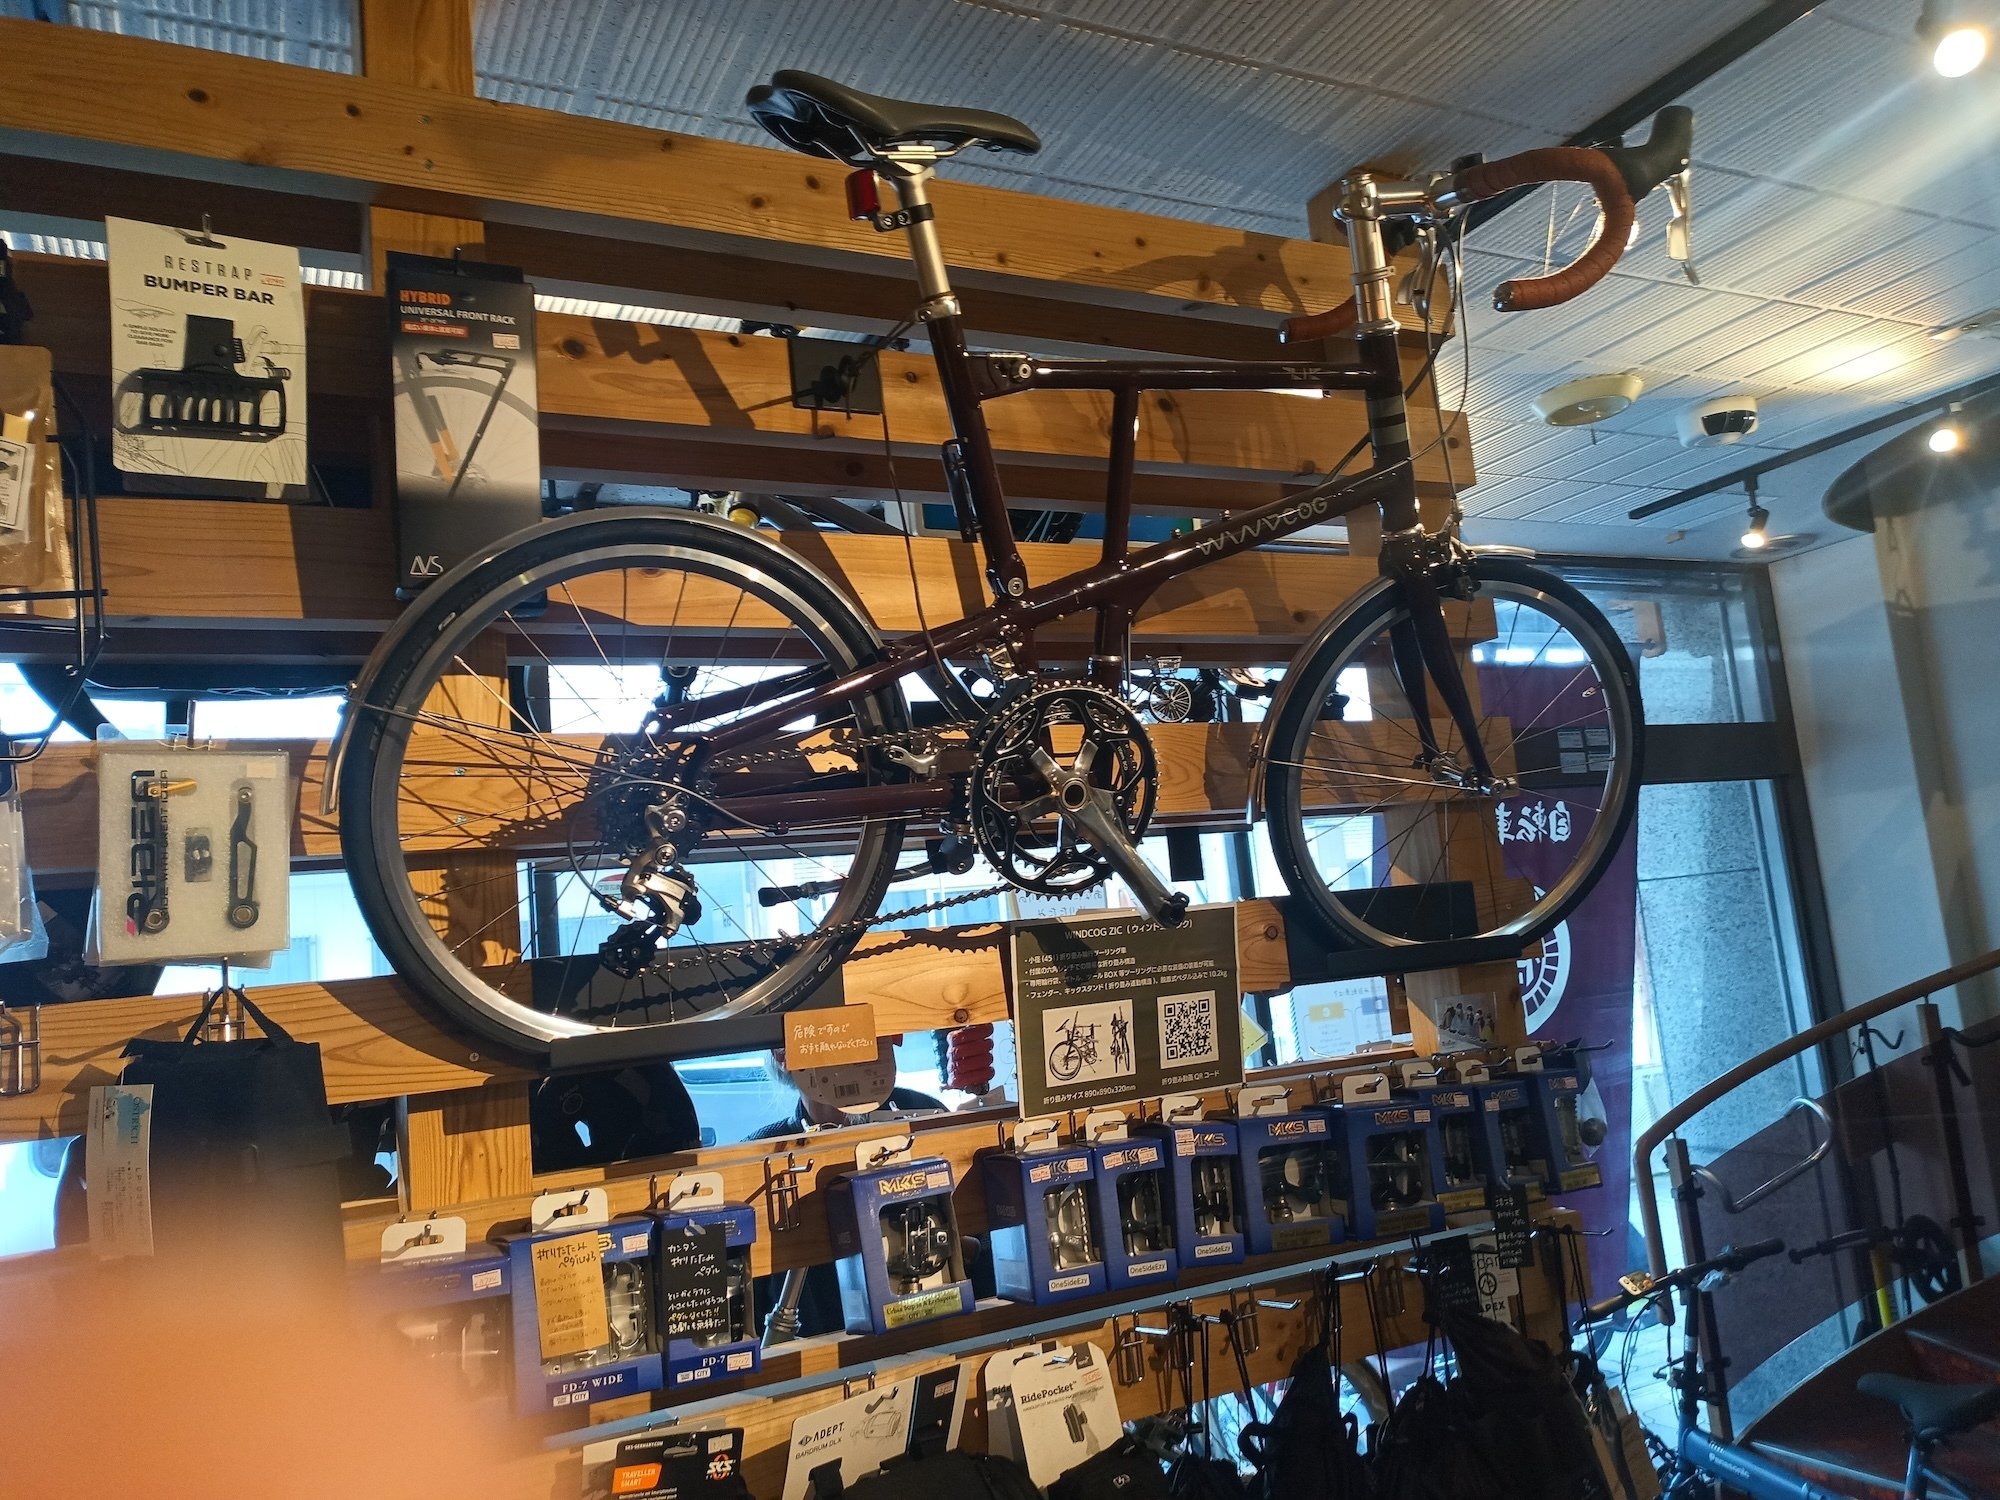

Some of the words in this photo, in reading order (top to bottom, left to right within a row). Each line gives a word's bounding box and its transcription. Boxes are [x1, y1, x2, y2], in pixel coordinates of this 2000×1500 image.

[164, 254, 253, 281] RESTRAP
[143, 274, 228, 299] BUMPER
[232, 288, 275, 306] BAR
[400, 289, 451, 306] HYBRID
[400, 305, 456, 319] UNIVERSAL
[456, 310, 489, 323] FRONT
[490, 314, 516, 326] RACK
[1064, 927, 1107, 940] WINDCOG
[1109, 925, 1123, 936] ZIC
[1374, 1109, 1409, 1126] MKS
[1267, 1119, 1307, 1137] MKS
[878, 1171, 926, 1196] MKS
[667, 1242, 697, 1253] カンタン
[1196, 1244, 1232, 1258] OneSideEzy
[694, 1265, 721, 1279] ペダル
[1129, 1262, 1167, 1276] OneSideEzy
[1050, 1276, 1089, 1291] OneSideEzy
[702, 1355, 726, 1367] FD-7
[562, 1379, 588, 1395] FD-7
[591, 1373, 624, 1388] WIDE
[573, 1392, 588, 1401] CITY
[621, 1468, 656, 1479] TRAVELLER
[707, 1459, 734, 1475] SKS
[620, 1478, 642, 1488] SMART
